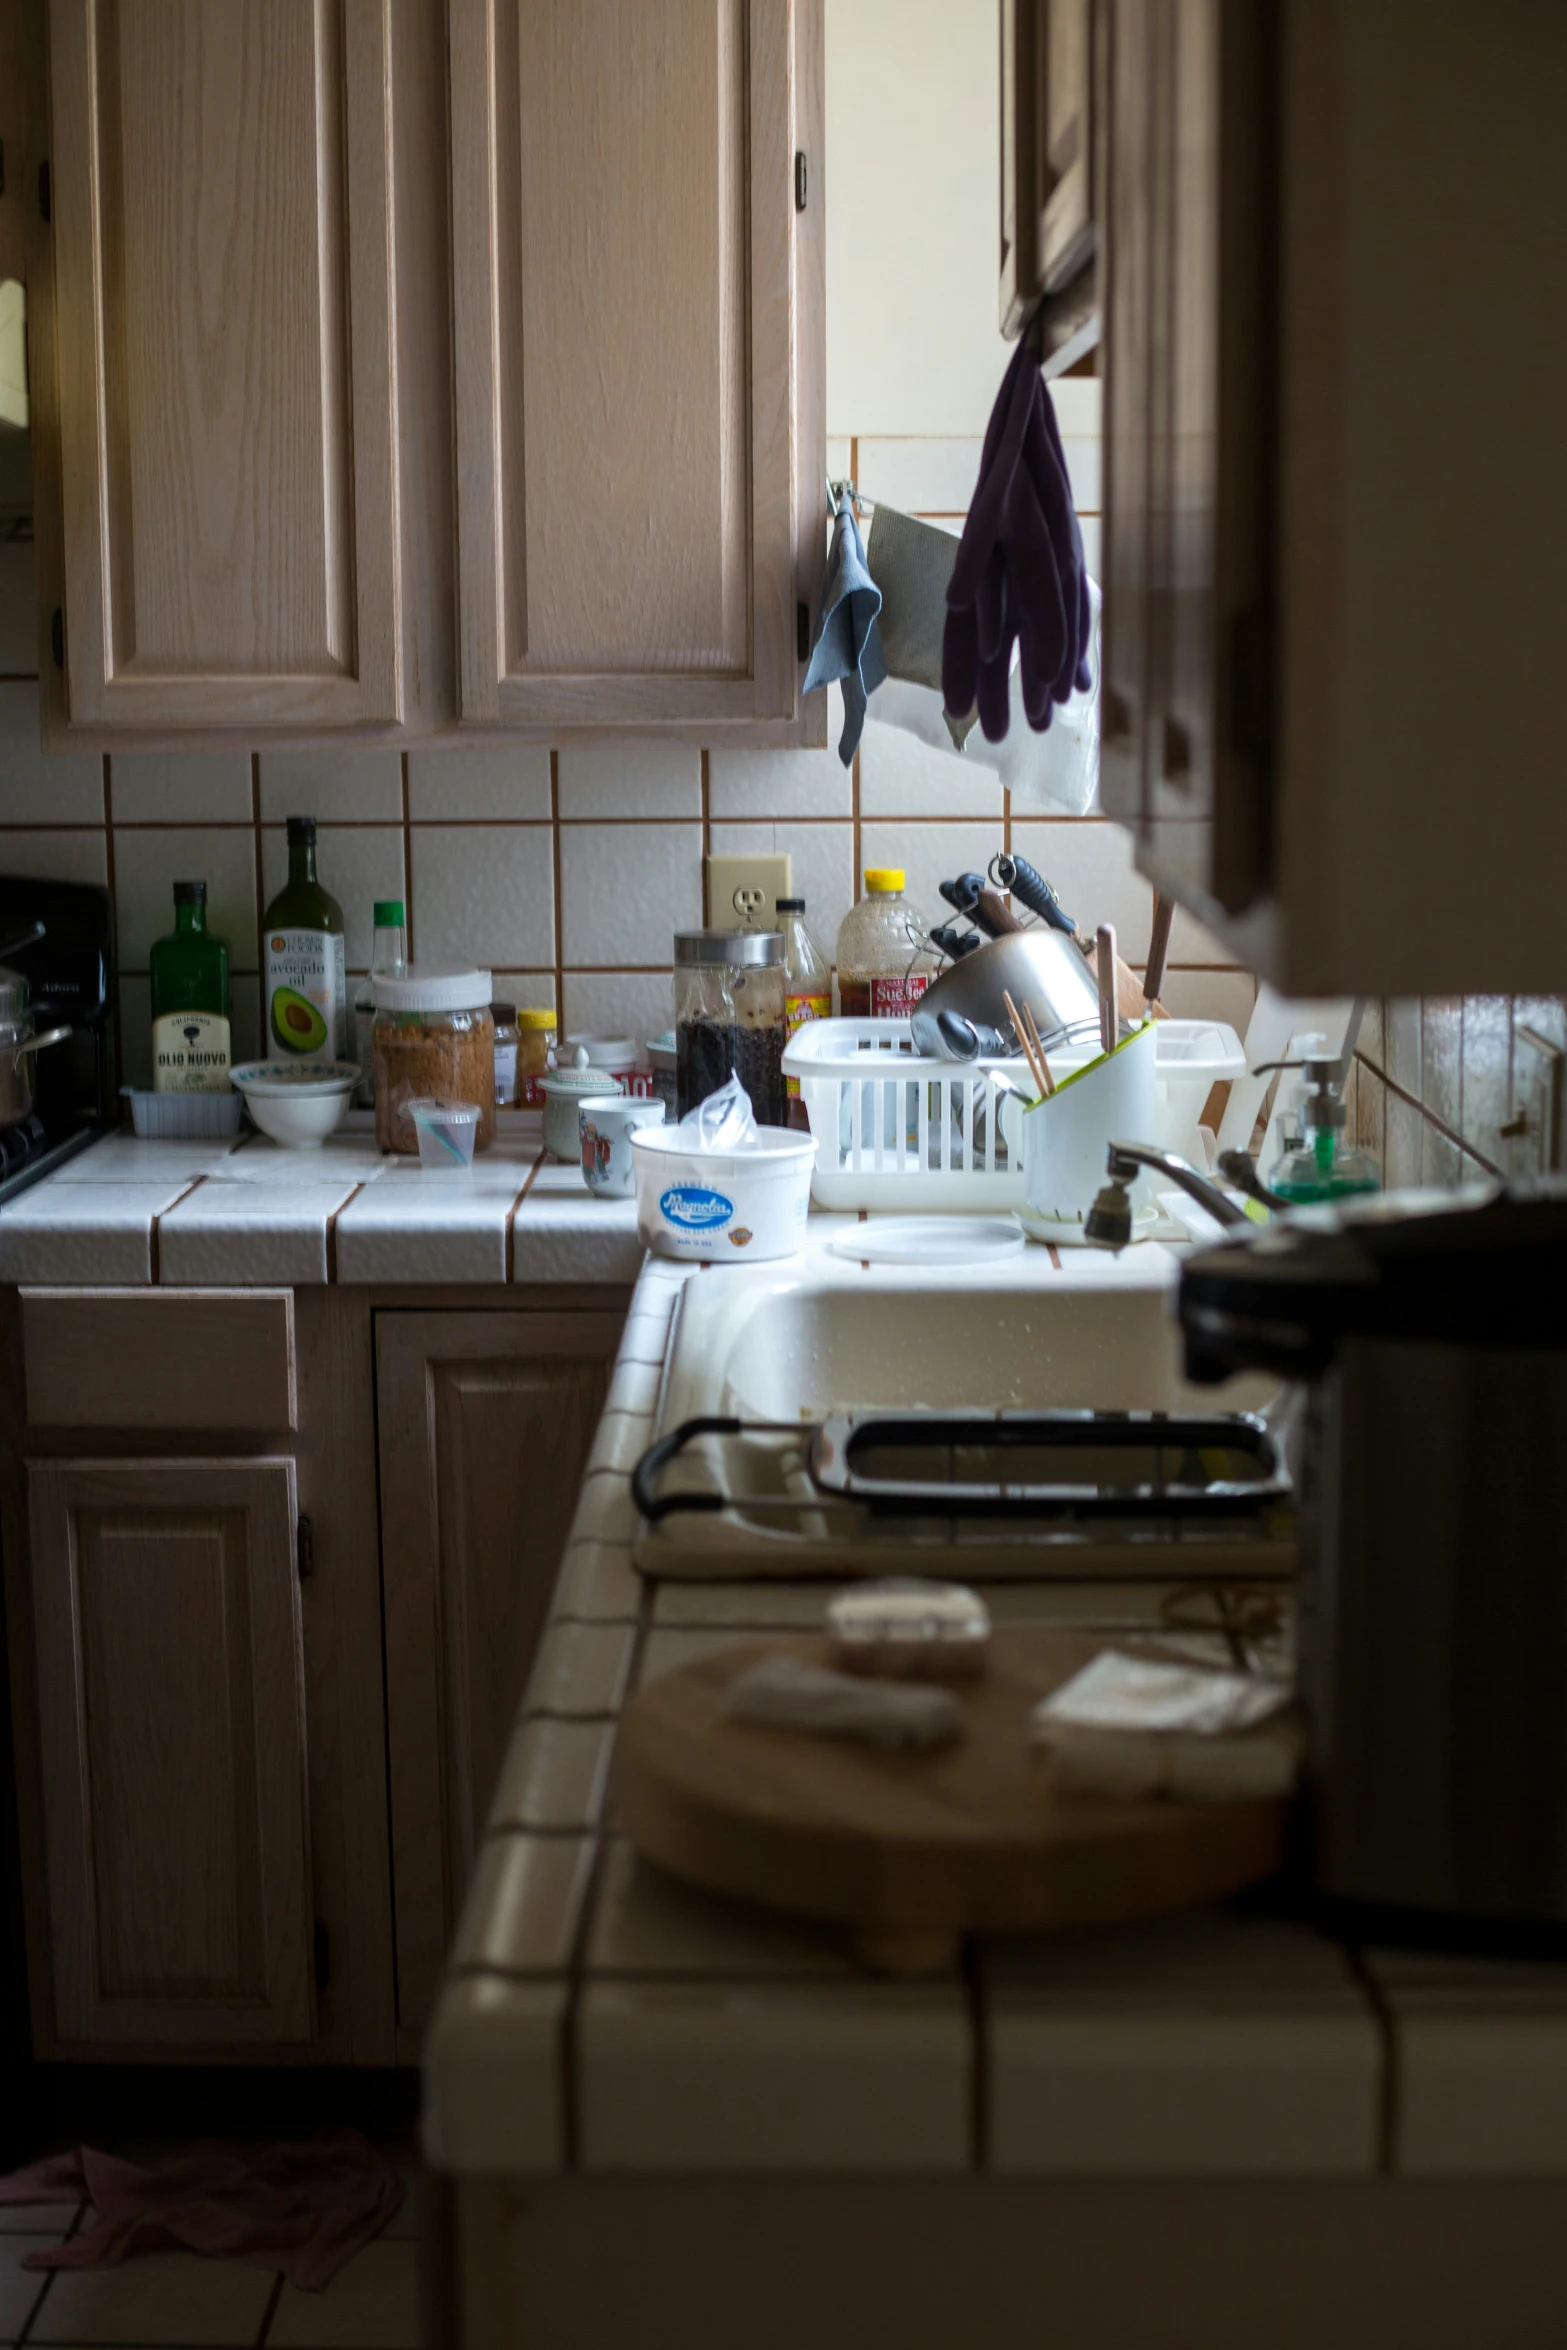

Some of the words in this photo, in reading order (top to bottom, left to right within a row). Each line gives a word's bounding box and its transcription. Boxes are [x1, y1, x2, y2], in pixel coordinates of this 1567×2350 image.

[270, 961, 325, 975] avocado
[289, 975, 305, 987] oil
[158, 1051, 184, 1067] OLIO
[187, 1051, 226, 1067] NUOVO
[663, 1192, 732, 1220] Magnolia
